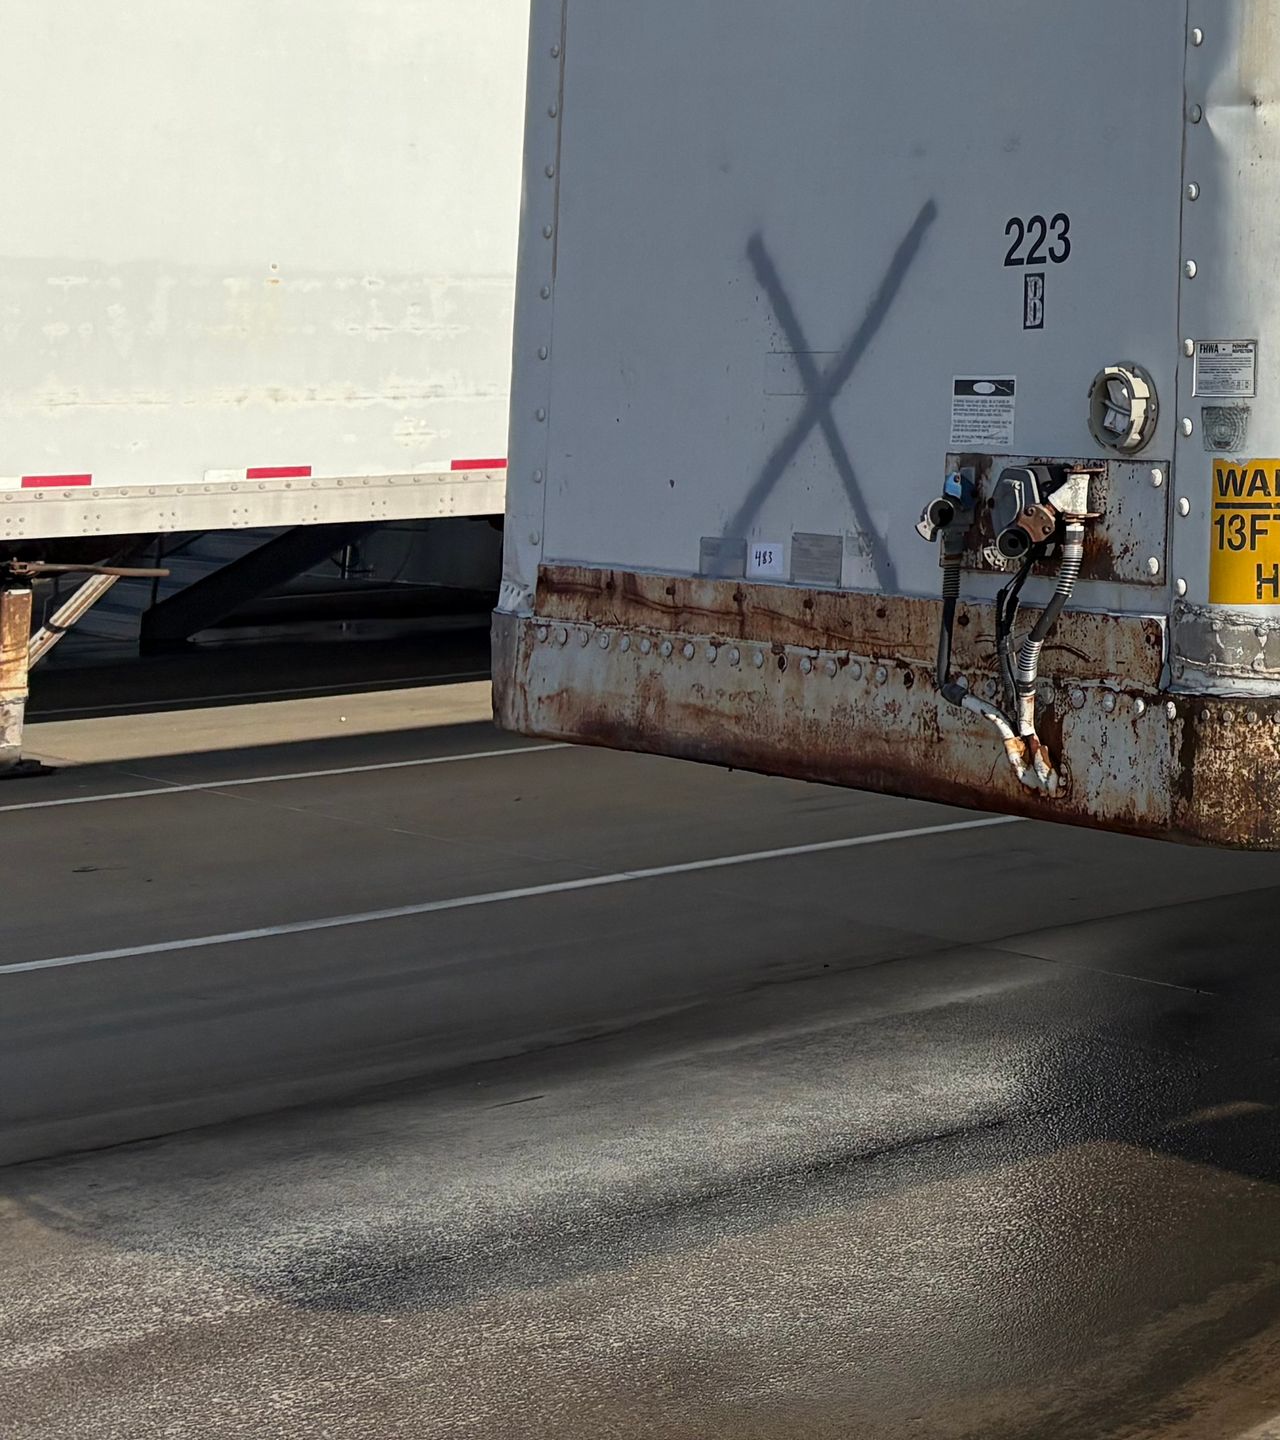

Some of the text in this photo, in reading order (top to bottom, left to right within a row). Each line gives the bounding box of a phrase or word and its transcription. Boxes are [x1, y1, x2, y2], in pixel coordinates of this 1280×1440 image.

[1004, 213, 1071, 266] 223
[1025, 275, 1043, 327] B
[755, 550, 773, 567] 483
